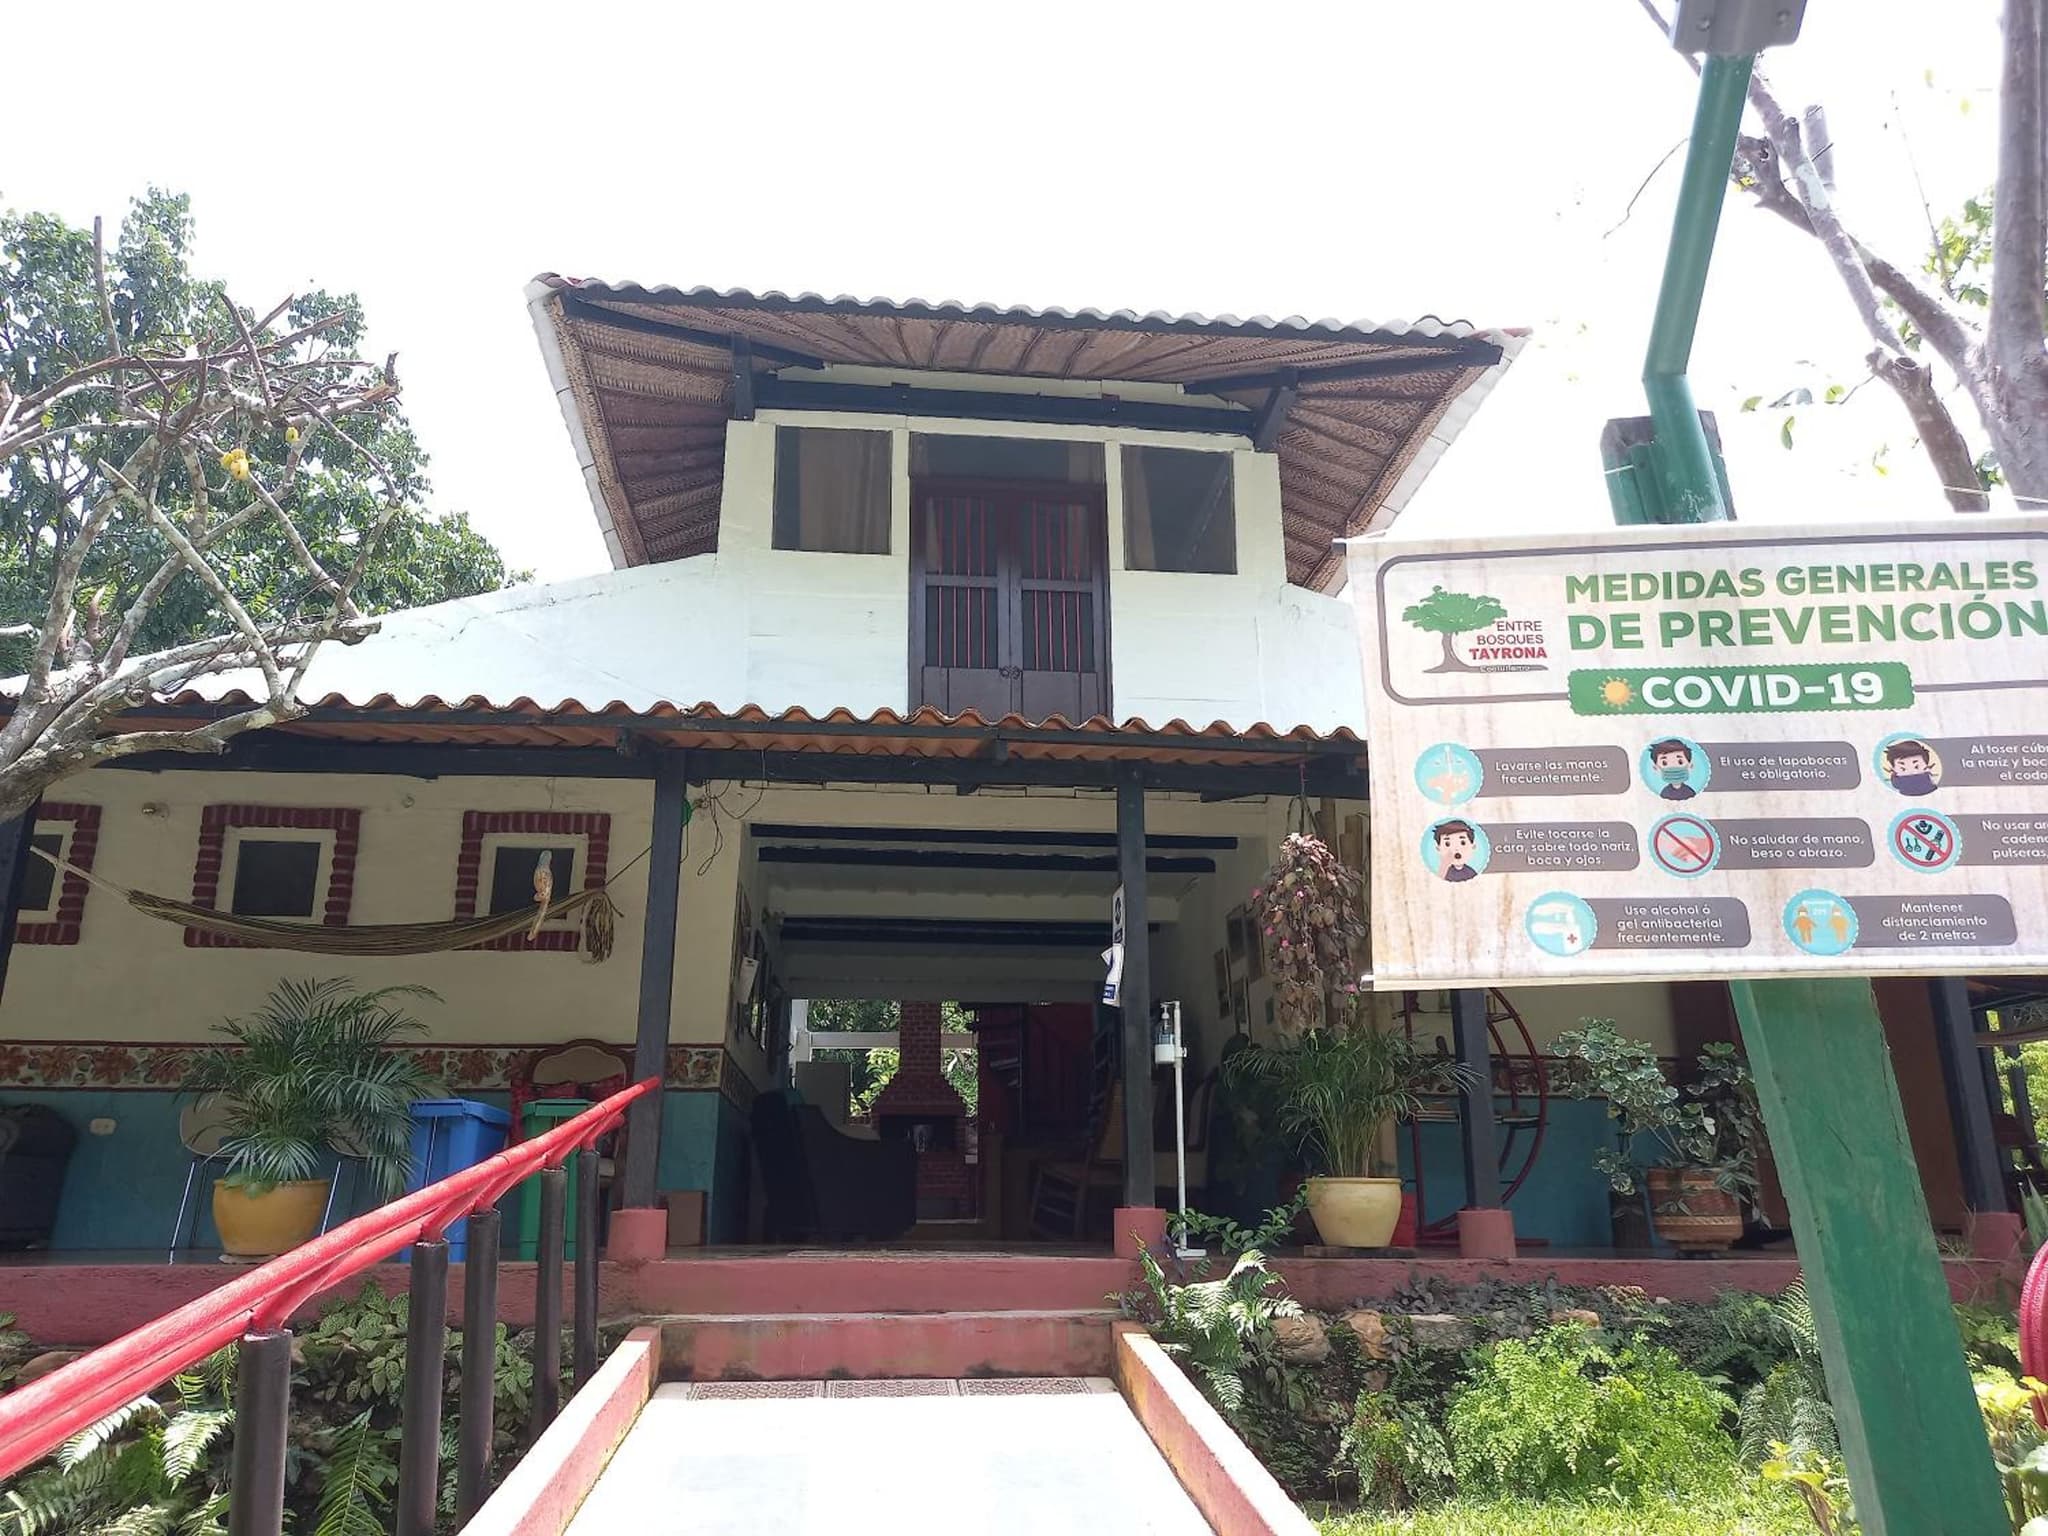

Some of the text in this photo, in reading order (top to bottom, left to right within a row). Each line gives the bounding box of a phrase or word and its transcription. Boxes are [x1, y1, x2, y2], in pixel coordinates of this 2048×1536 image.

[1566, 560, 2039, 604] MEDIDAS GENERALES
[1496, 620, 1543, 632] ENTRE
[1568, 593, 2048, 651] DE PREVENCIÓN
[1476, 634, 1544, 646] BOSQUES
[1468, 647, 1548, 660] TAYRONA
[1641, 670, 1884, 709] COVID-19
[1971, 743, 1984, 754] Al
[1987, 743, 2018, 754] toser
[1495, 759, 1608, 771] Lavarse las manos
[1720, 755, 1847, 768] El uso de tapabocas
[1961, 758, 1974, 768] la
[1978, 757, 2009, 768] nariz
[2011, 758, 2020, 769] y
[1501, 771, 1604, 784] frecuentemente.
[1741, 768, 1830, 781] es obligatorio.
[2000, 770, 2012, 781] el
[1981, 820, 2001, 831] No
[2004, 821, 2030, 830] usar
[1515, 828, 1610, 840] Evite tocarse la
[1729, 833, 1865, 846] No saludar de mano,
[1494, 843, 1527, 854] cara,
[1531, 842, 1565, 853] sobre
[1568, 841, 1599, 852] todo
[1750, 846, 1847, 858] beso o abrazo.
[1527, 854, 1605, 868] boca y ojos.
[1624, 905, 1648, 916] Use
[1650, 904, 1698, 915] alcohol
[1901, 902, 1964, 914] Mantener
[1617, 917, 1723, 931] gel antibacterial
[1881, 915, 1988, 927] distanciamiento
[1617, 931, 1725, 943] frecuentemente.
[1898, 930, 1977, 941] de 2 metros
